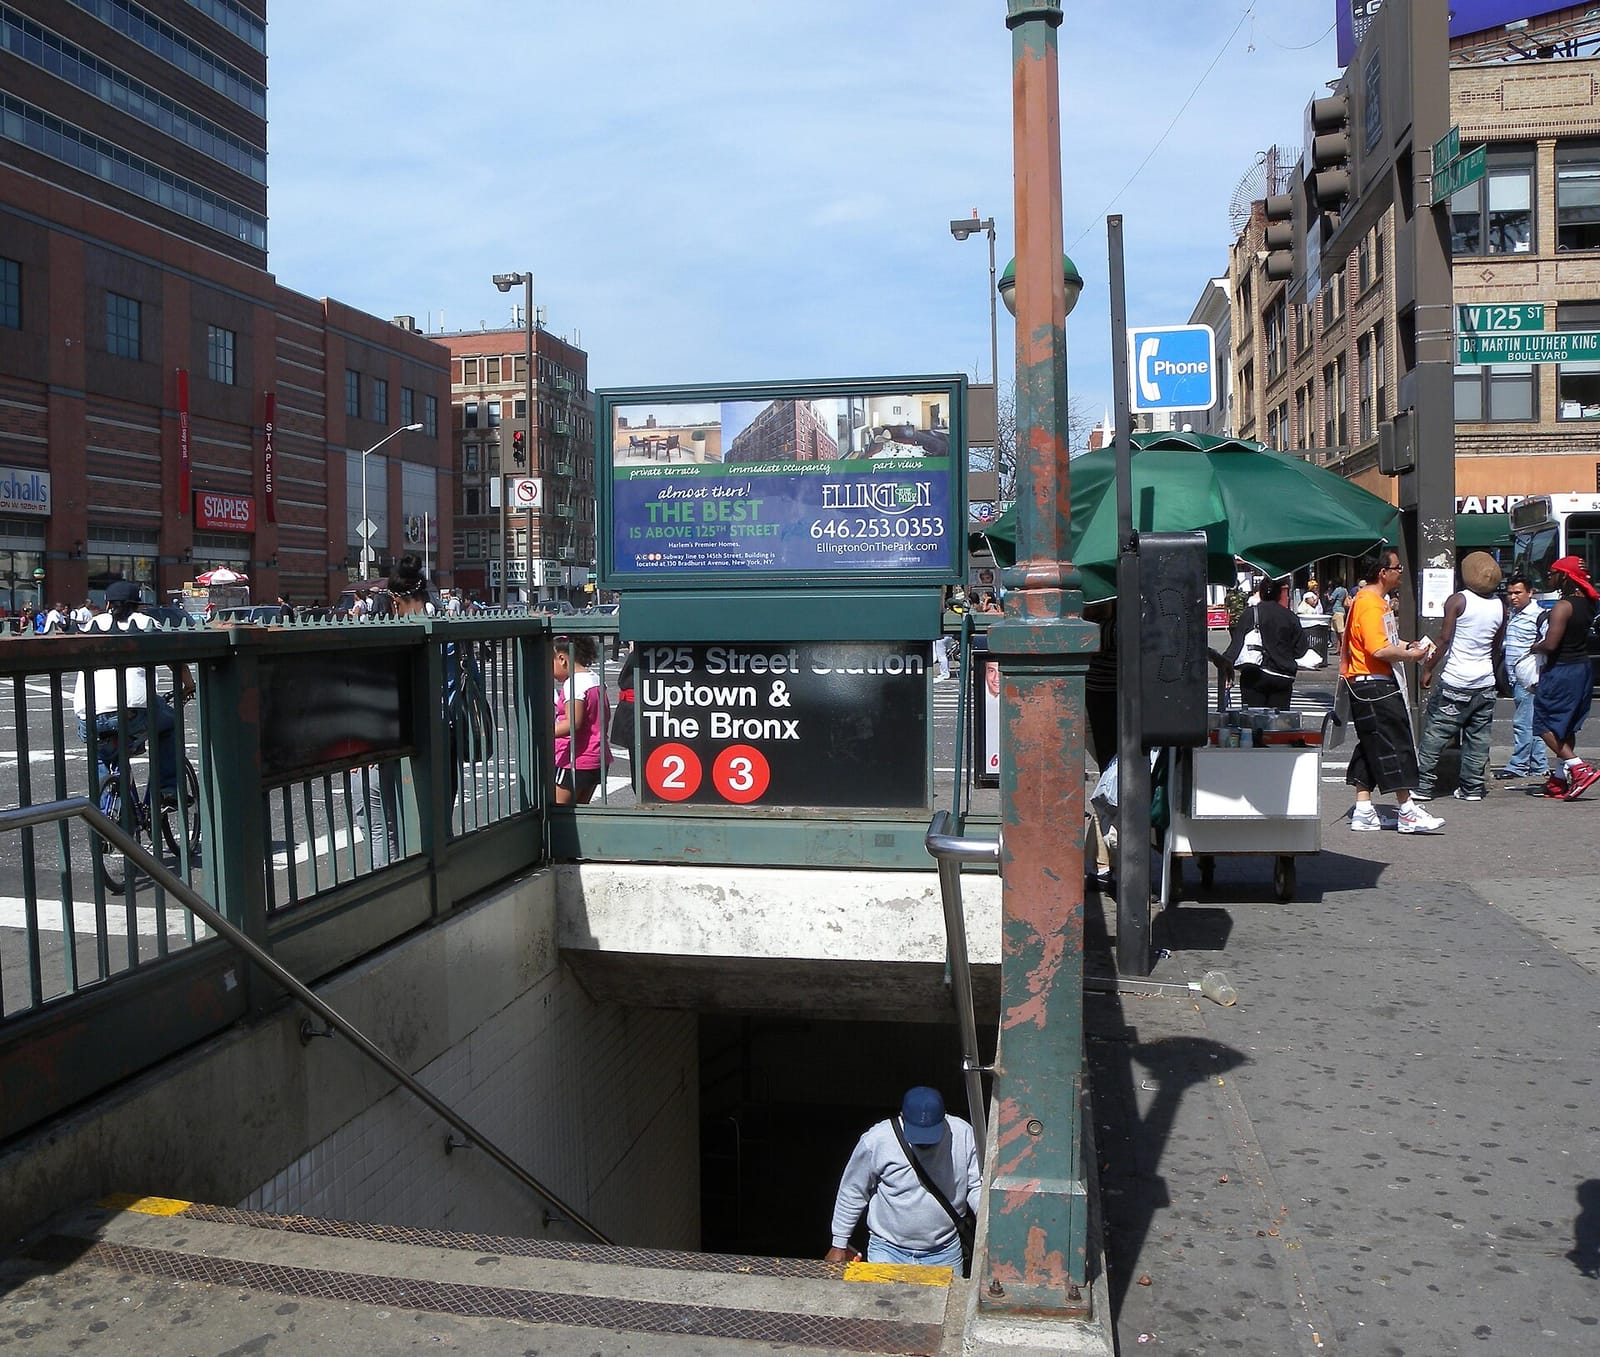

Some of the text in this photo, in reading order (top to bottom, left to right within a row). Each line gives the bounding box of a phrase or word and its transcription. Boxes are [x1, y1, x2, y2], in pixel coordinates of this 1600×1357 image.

[1463, 306, 1543, 330] W 125 ST
[1463, 336, 1597, 352] DR. MARTIN LUTHER KING
[1508, 351, 1568, 361] BOULEVARD
[1154, 360, 1208, 376] Phone
[265, 422, 273, 493] STAPLES
[897, 459, 924, 470] views
[630, 466, 700, 481] private terraces
[729, 463, 831, 476] immediate occupancy
[658, 482, 752, 499] almost there!
[204, 495, 249, 521] STAPLES
[645, 500, 764, 523] THE BEST
[630, 524, 780, 539] IS ABOVE 125TH STREET
[810, 517, 945, 539] 646.253.0353
[816, 541, 938, 554] EllingtonOnThePark.com
[663, 553, 685, 561] Subway
[744, 552, 769, 560] Building
[678, 559, 706, 567] Bradhurst
[642, 647, 924, 675] 125 Street Station
[642, 679, 792, 711] Uptown &
[642, 711, 801, 740] The Bronx
[662, 755, 754, 791] 2 3
